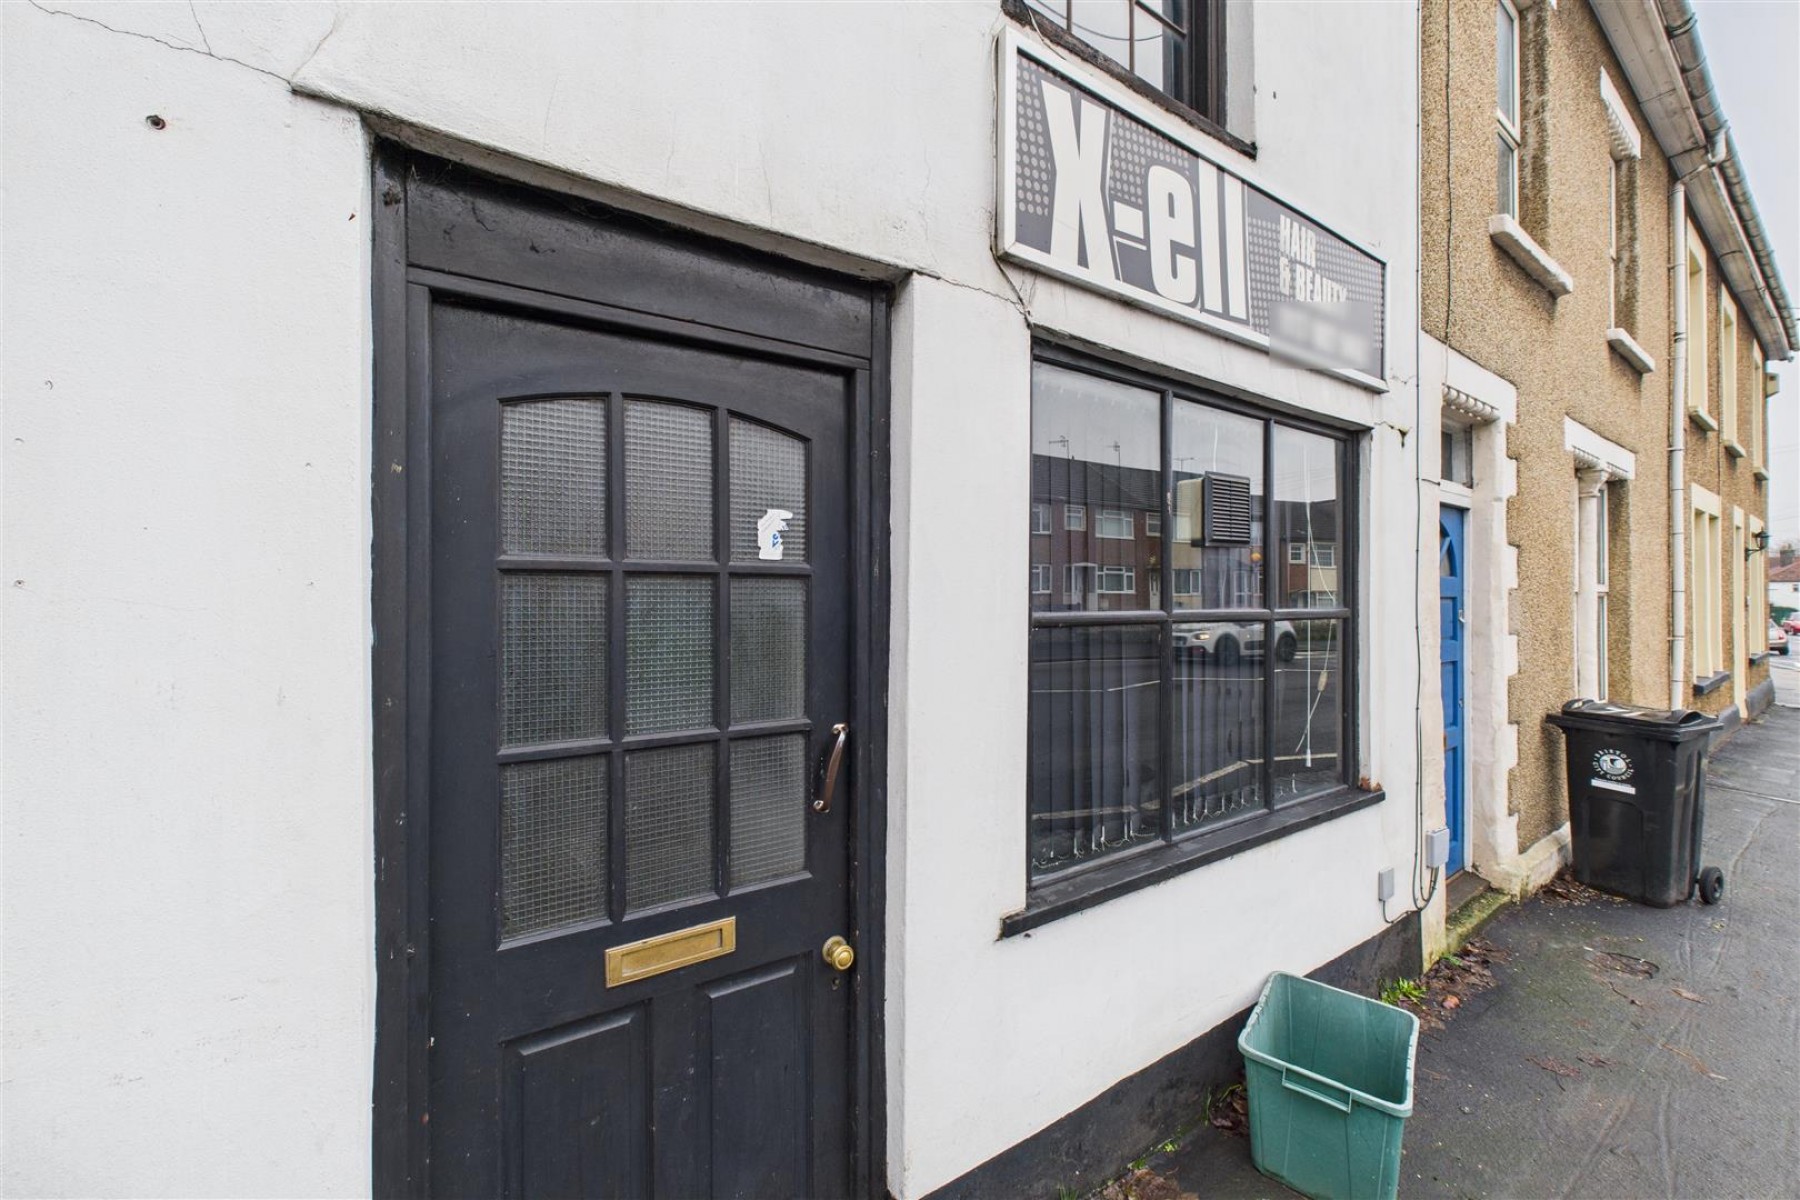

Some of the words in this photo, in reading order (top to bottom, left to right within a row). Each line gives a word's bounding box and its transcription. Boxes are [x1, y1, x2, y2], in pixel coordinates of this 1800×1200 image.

[1041, 80, 1247, 320] X-ell
[1280, 214, 1316, 268] HAIR
[1280, 256, 1290, 297] &
